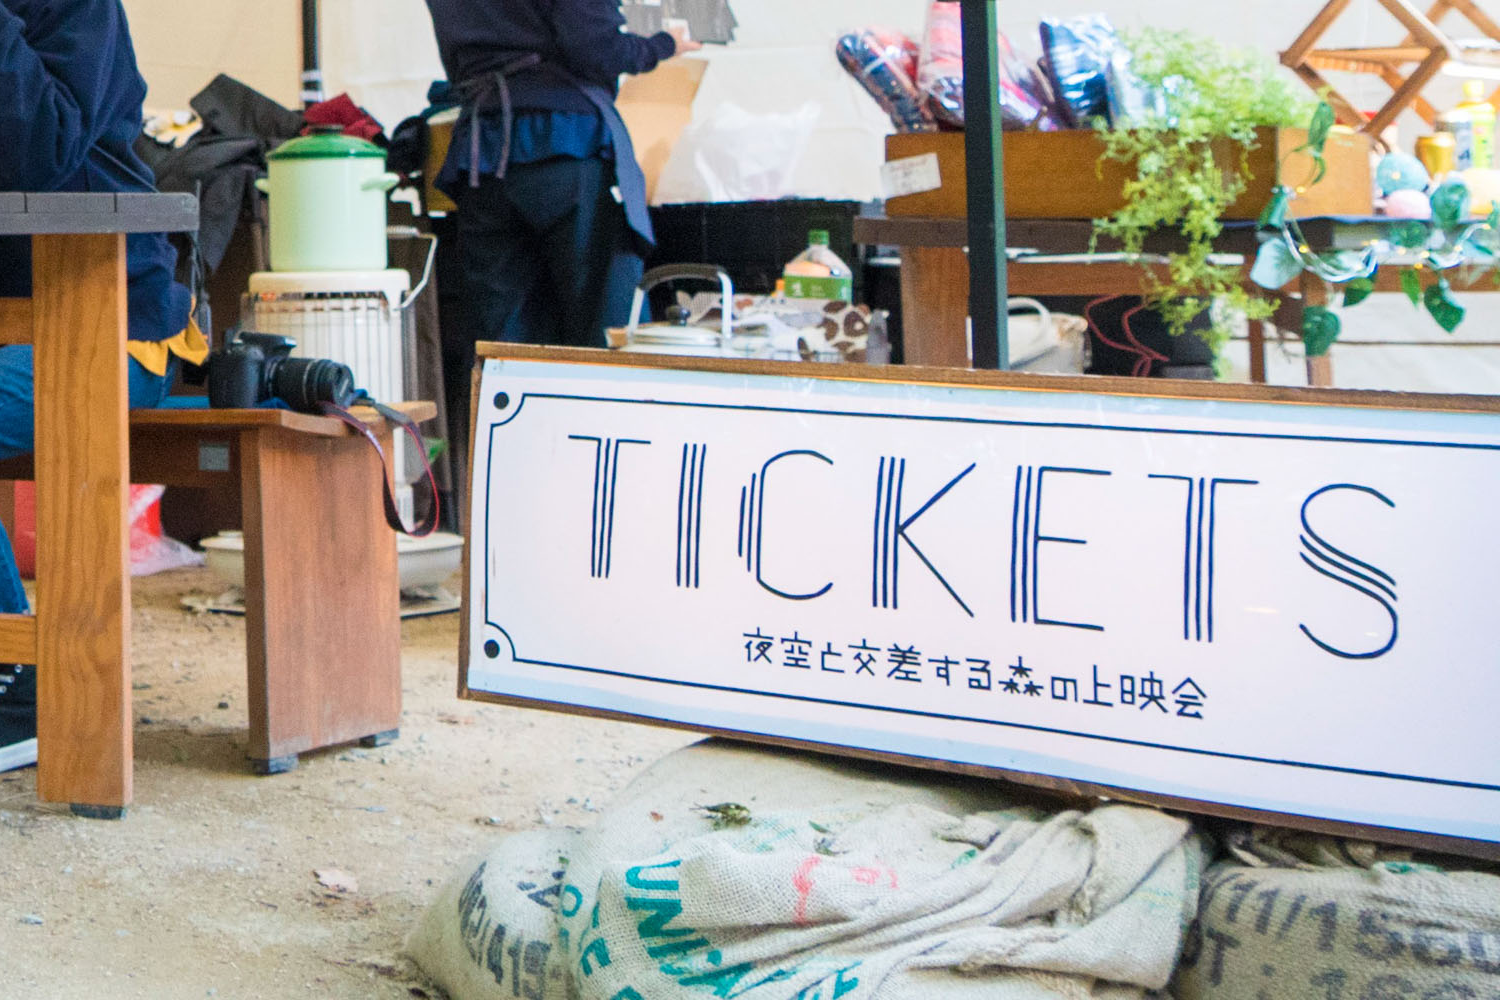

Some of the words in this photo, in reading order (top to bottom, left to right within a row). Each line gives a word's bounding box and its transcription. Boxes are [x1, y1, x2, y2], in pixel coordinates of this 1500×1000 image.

[568, 434, 1399, 660] TICKETS
[742, 627, 1208, 720] 夜空と交差する森の上映会
